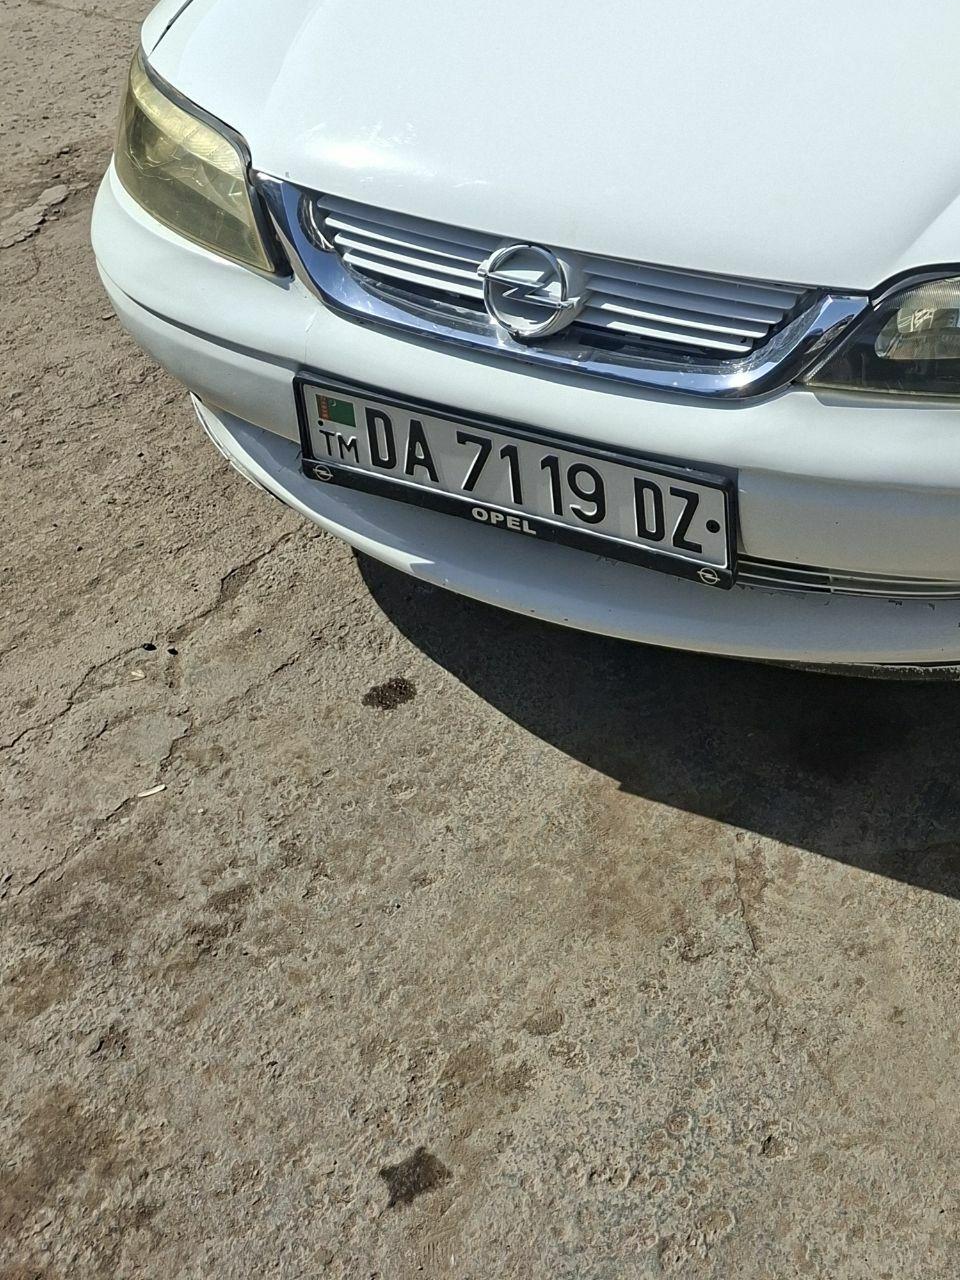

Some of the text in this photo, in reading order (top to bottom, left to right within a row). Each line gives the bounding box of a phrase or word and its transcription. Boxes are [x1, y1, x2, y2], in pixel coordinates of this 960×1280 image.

[319, 406, 702, 554] TM DA 7119 DZ
[472, 506, 537, 536] OPEL
